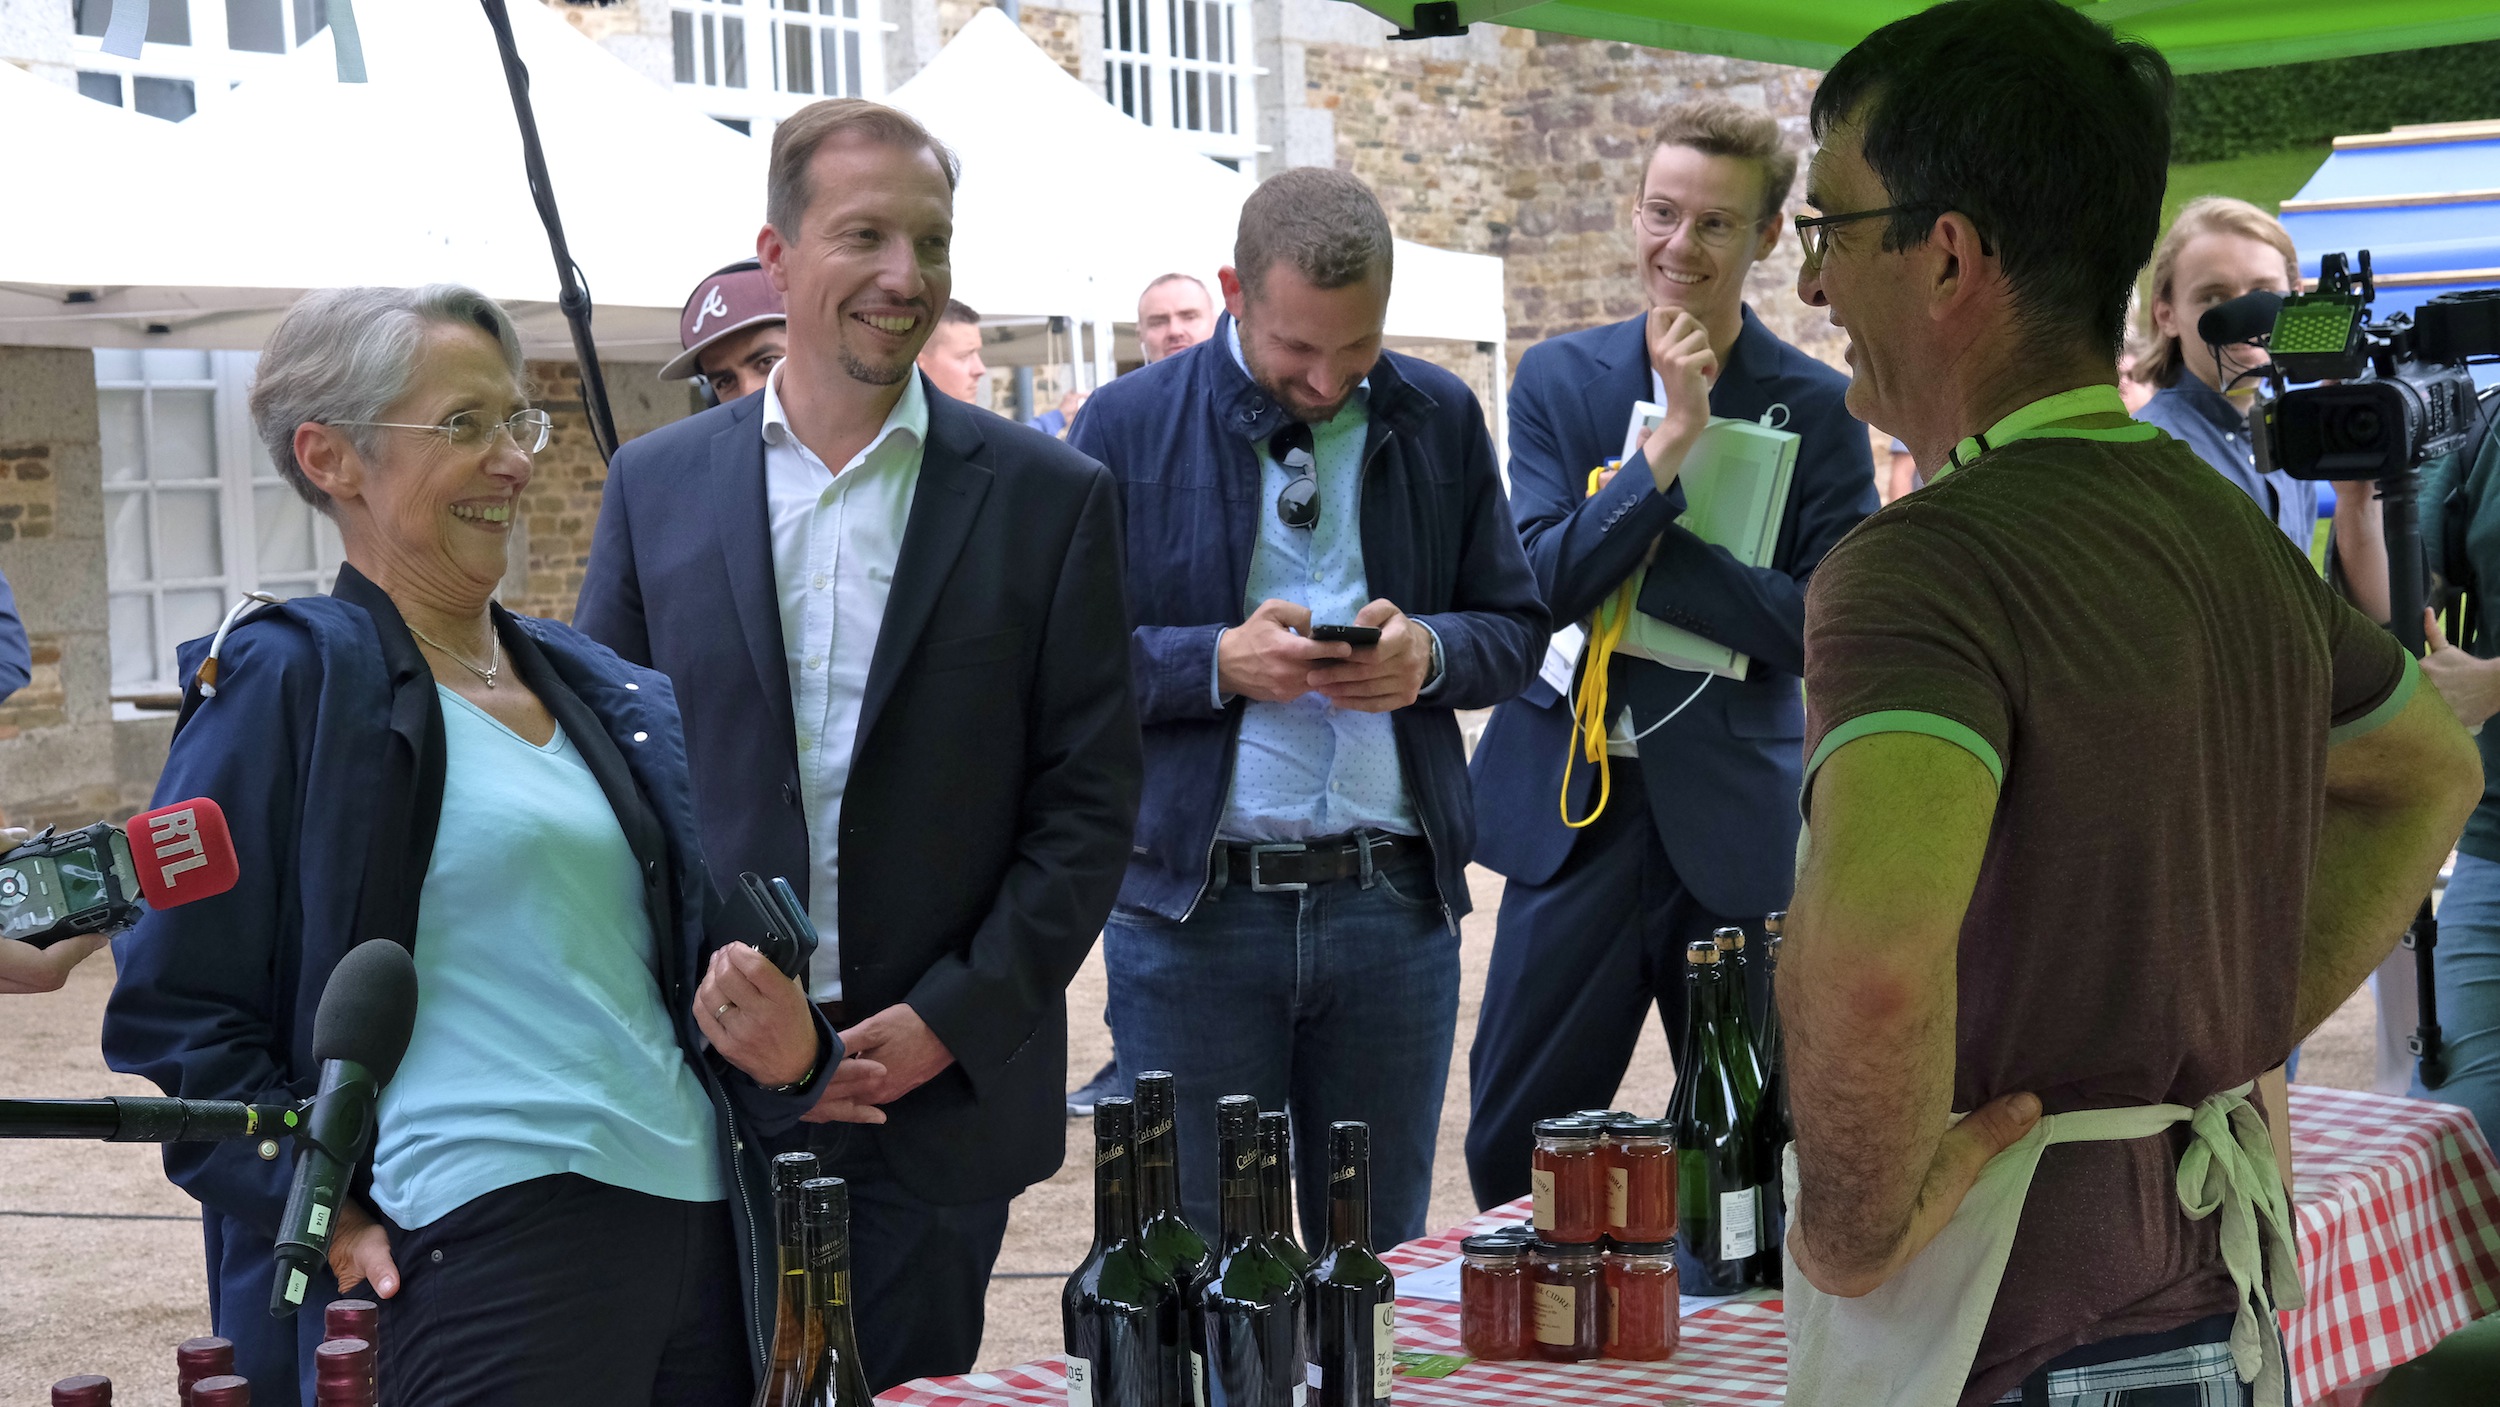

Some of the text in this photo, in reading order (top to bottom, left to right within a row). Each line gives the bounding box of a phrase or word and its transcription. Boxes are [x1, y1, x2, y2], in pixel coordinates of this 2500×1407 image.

[692, 285, 728, 334] A
[148, 807, 209, 889] RTL
[1607, 1173, 1624, 1192] IDRE
[316, 1212, 325, 1226] U14
[1545, 1289, 1572, 1310] CIDRE
